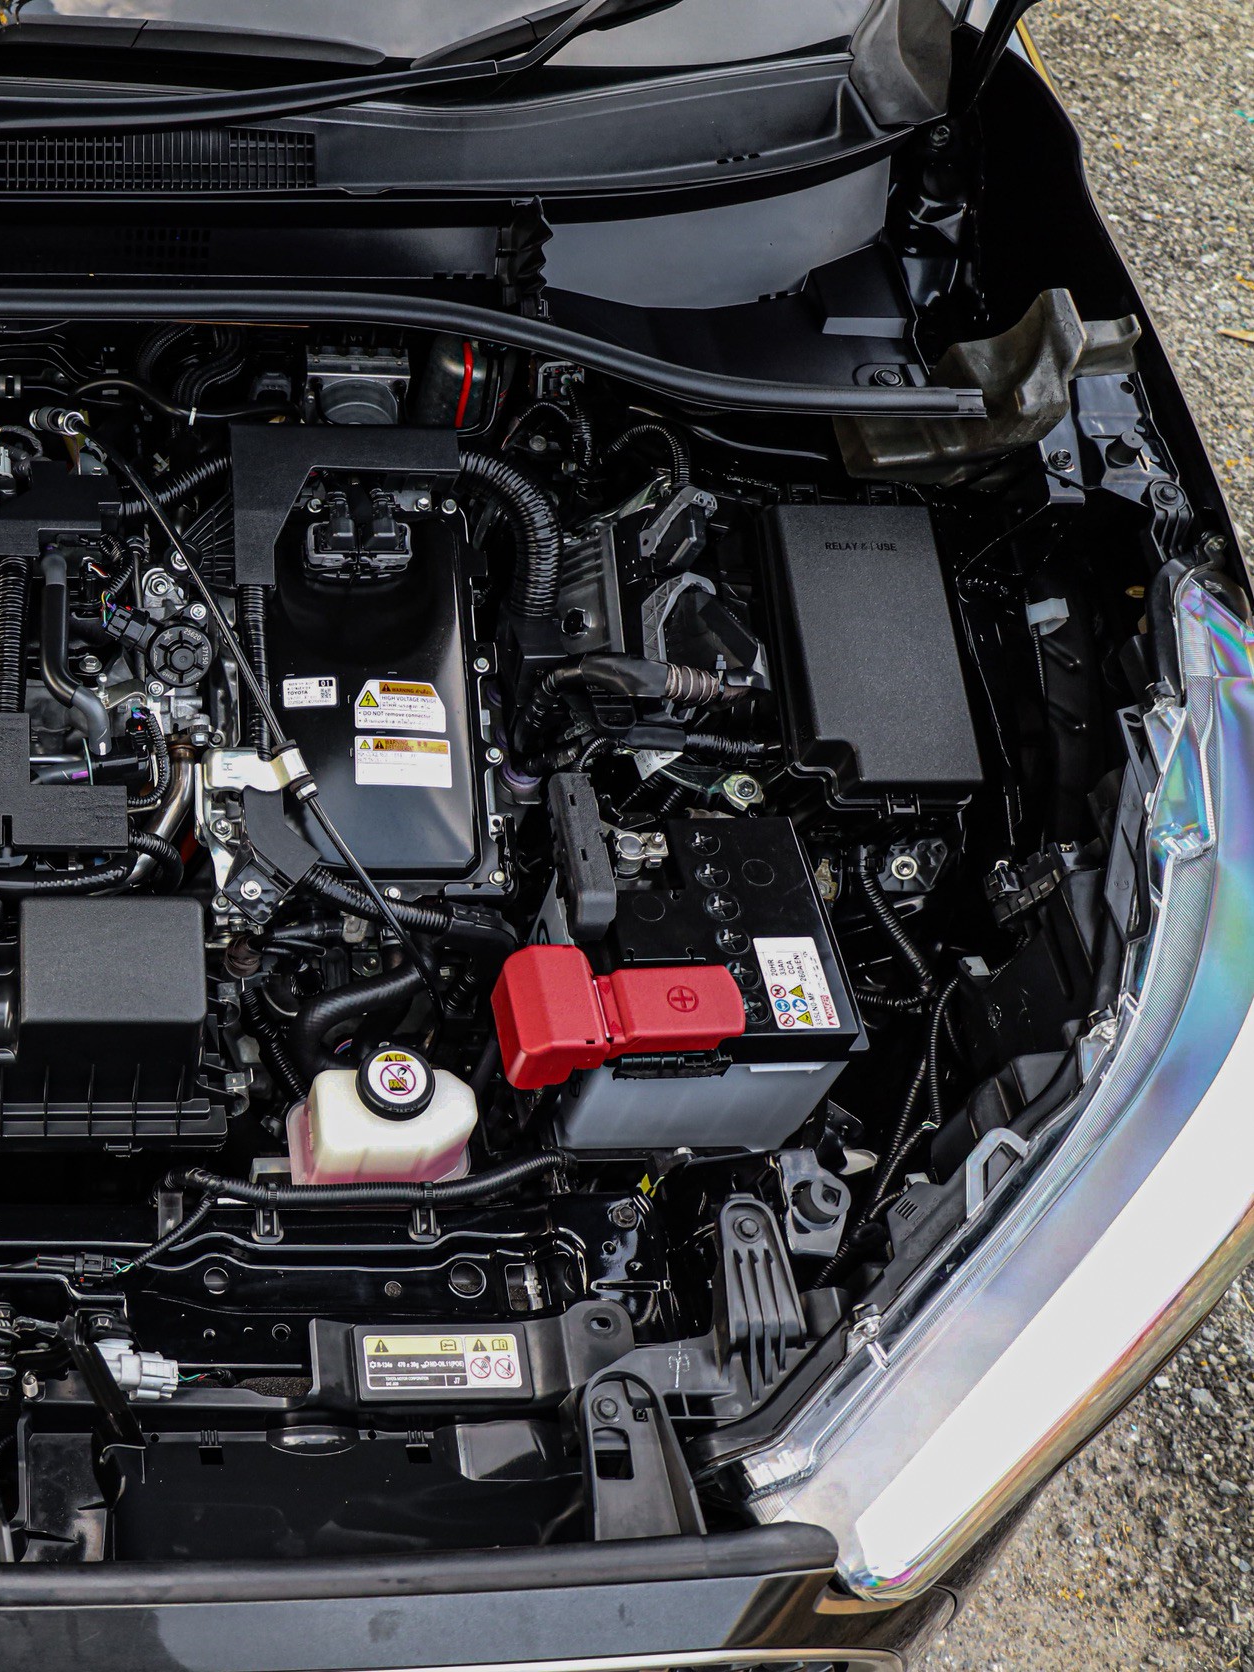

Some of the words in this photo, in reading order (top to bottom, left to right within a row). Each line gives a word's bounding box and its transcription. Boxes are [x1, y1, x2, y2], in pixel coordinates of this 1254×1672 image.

[825, 542, 857, 550] RELAY
[183, 627, 202, 640] 25620
[786, 960, 795, 975] CCA
